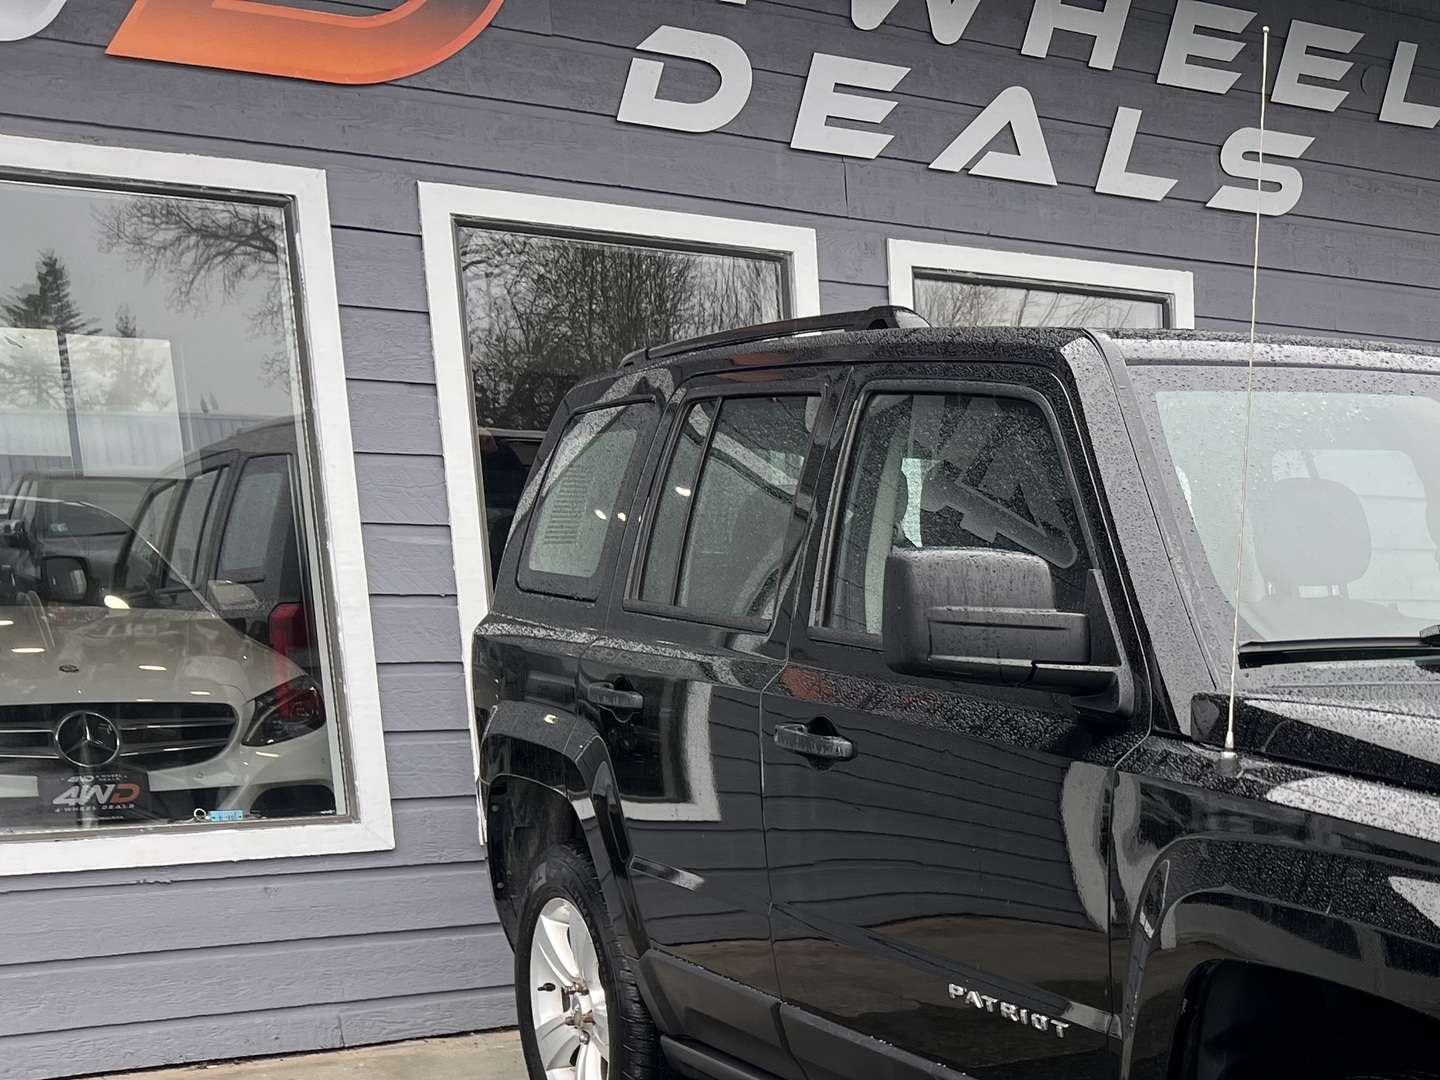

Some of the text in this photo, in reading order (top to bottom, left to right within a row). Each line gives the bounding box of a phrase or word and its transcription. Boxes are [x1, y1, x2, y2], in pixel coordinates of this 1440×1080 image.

[616, 24, 1316, 217] DEALS
[52, 783, 141, 806] 4WD
[949, 983, 1071, 1039] PATRIOT
